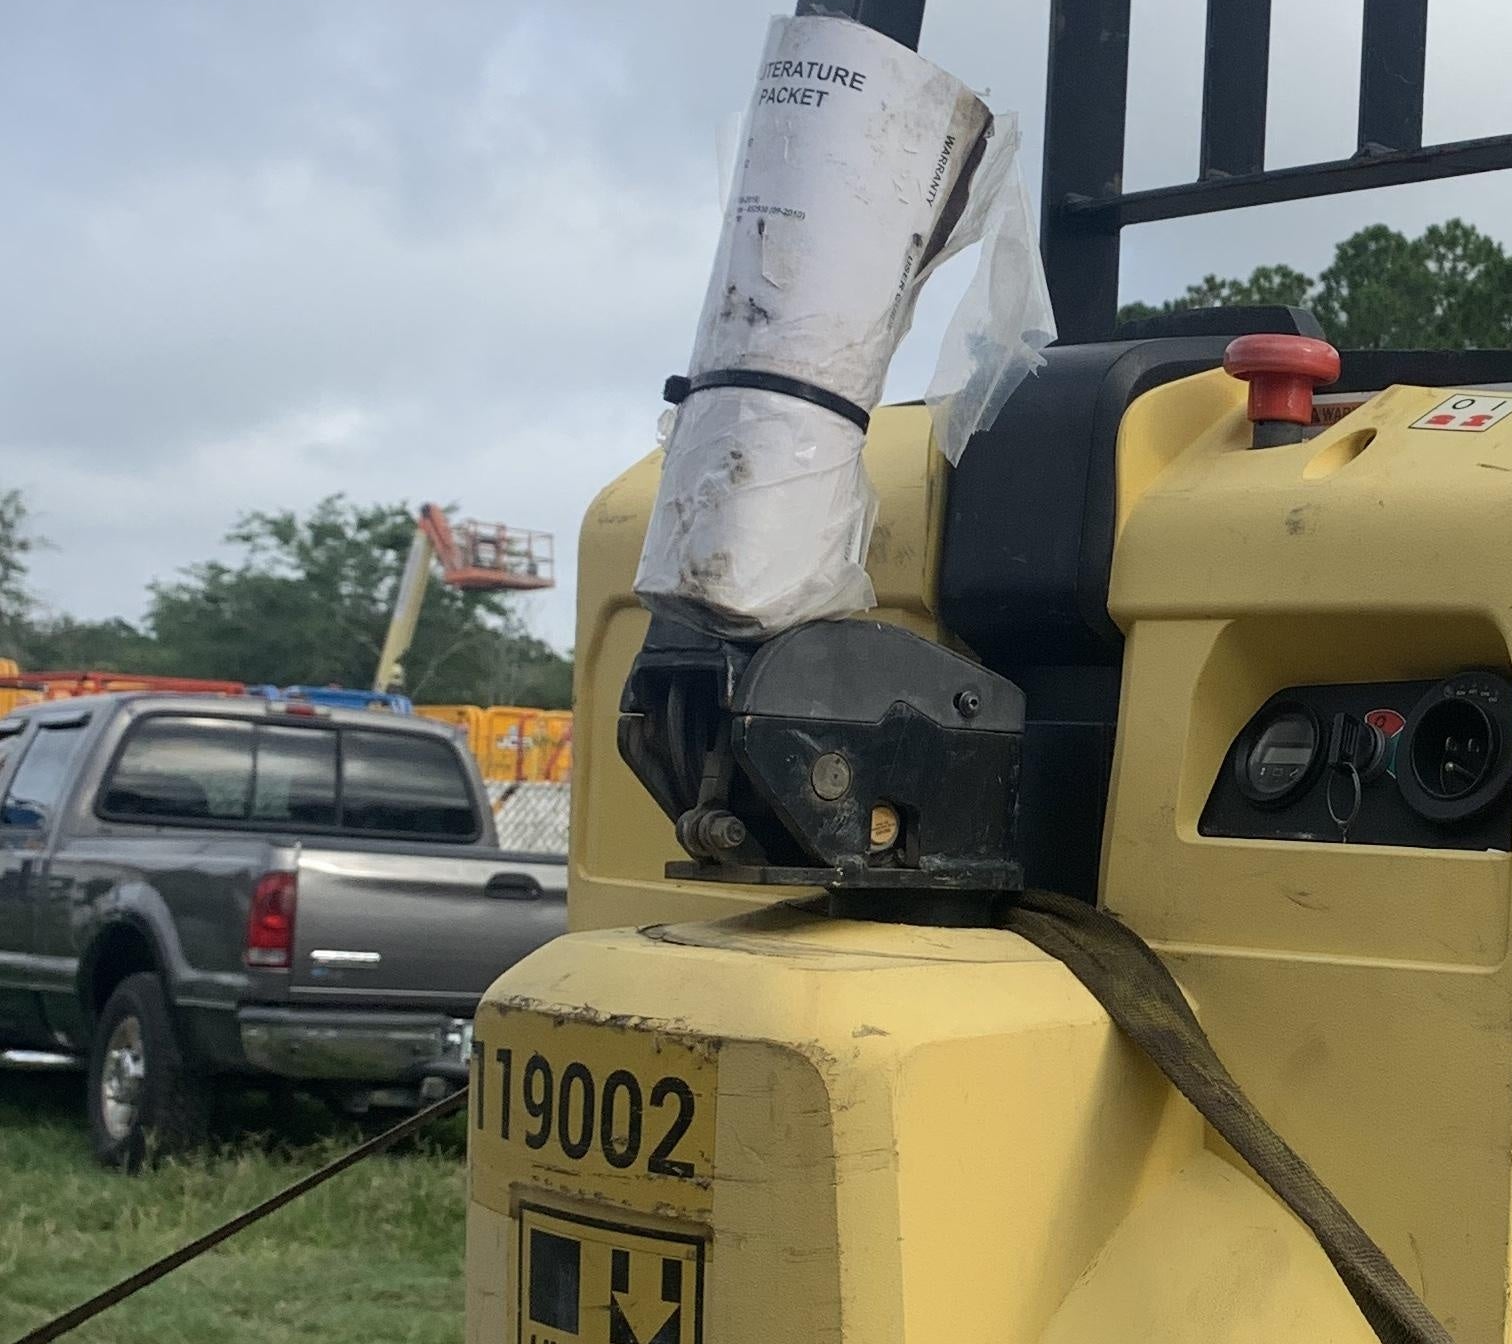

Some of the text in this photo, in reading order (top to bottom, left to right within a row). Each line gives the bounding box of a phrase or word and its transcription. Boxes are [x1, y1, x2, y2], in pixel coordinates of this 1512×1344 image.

[758, 86, 830, 108] PACKET
[760, 60, 867, 92] ITERATURE
[927, 134, 956, 208] WARRANTY
[471, 1038, 696, 1179] 119002
